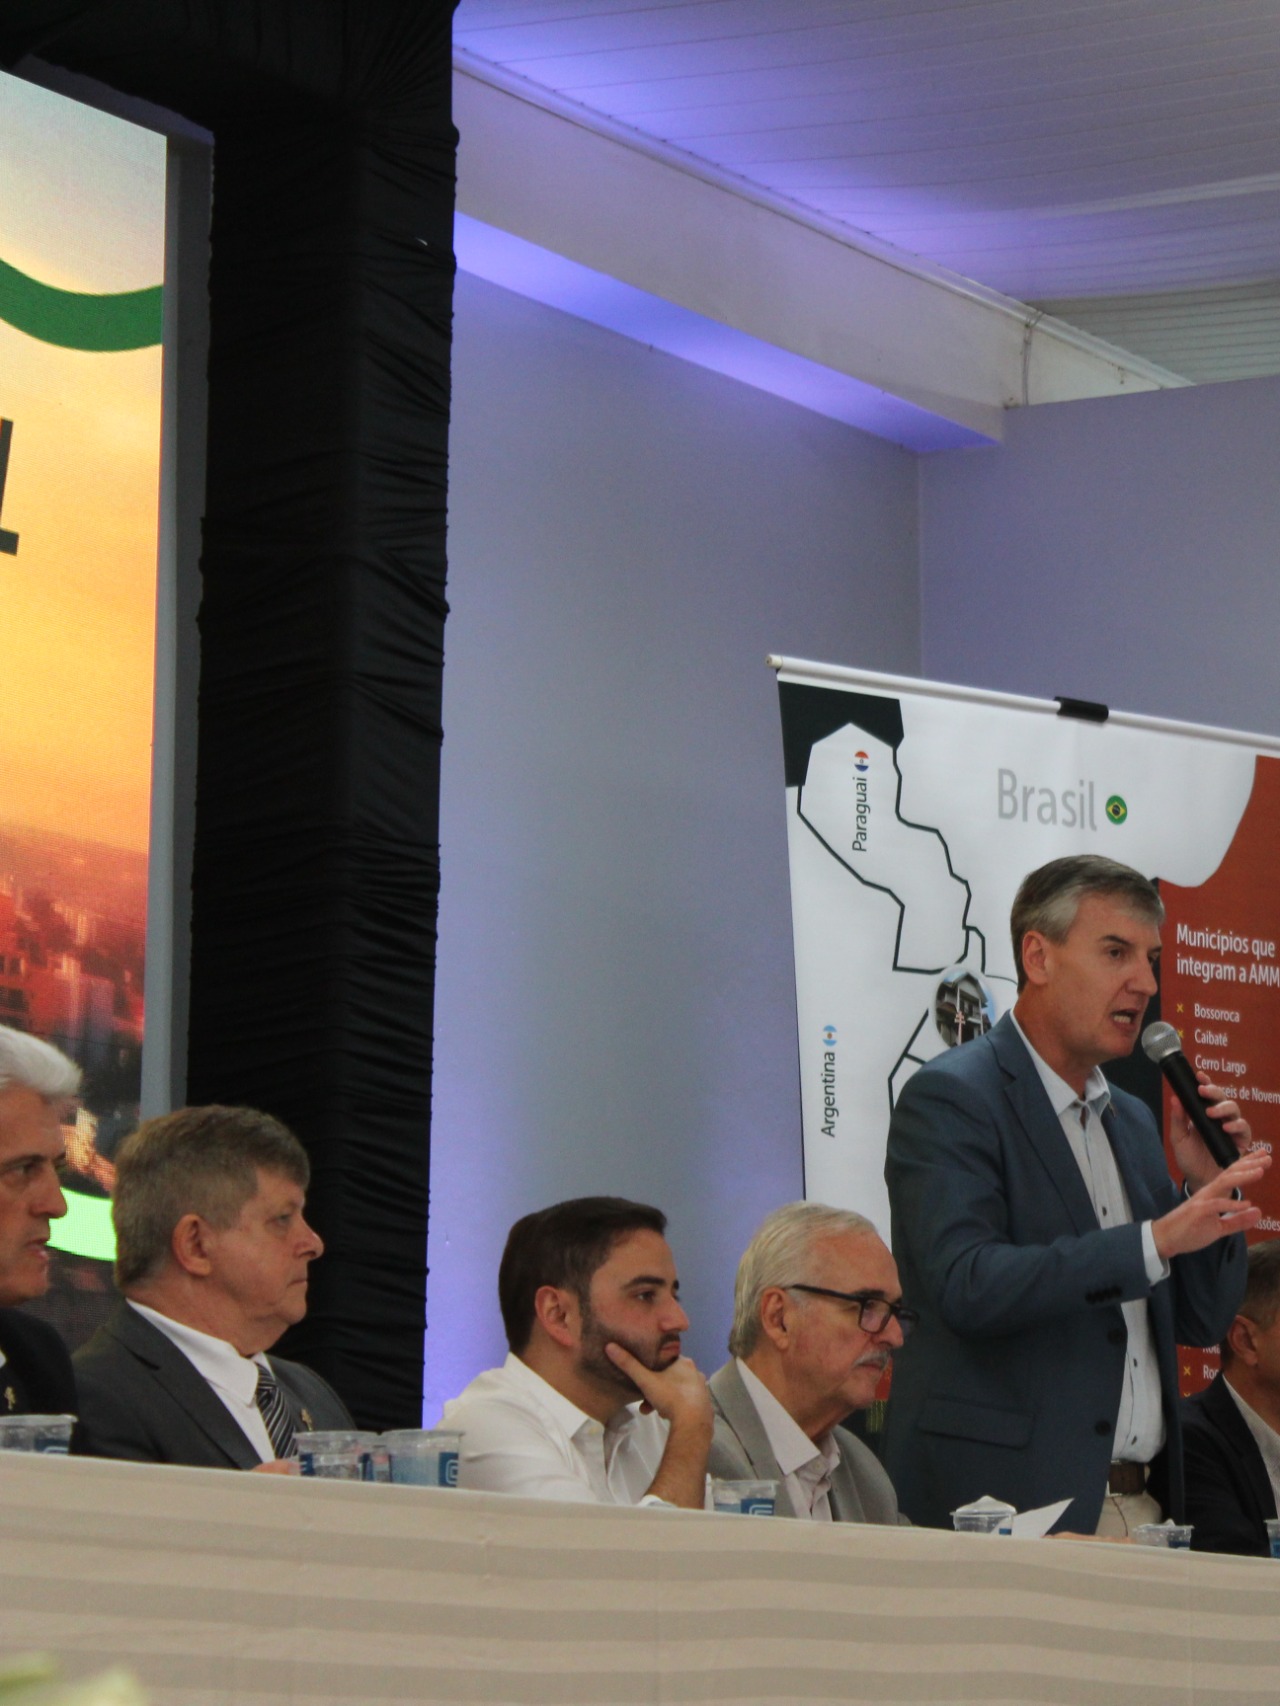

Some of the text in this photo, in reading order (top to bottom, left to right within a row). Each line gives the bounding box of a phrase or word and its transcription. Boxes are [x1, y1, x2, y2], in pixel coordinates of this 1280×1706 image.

[852, 777, 870, 852] Paraguai
[997, 768, 1097, 832] Brasil
[1176, 923, 1275, 960] Municípios que
[1176, 953, 1280, 988] integram a AMM
[1194, 1003, 1240, 1023] Bossoroca
[1194, 1029, 1228, 1047] Caibaté
[1195, 1054, 1247, 1077] Cerro Largo
[820, 1051, 839, 1138] Argentina
[1239, 1086, 1250, 1100] de
